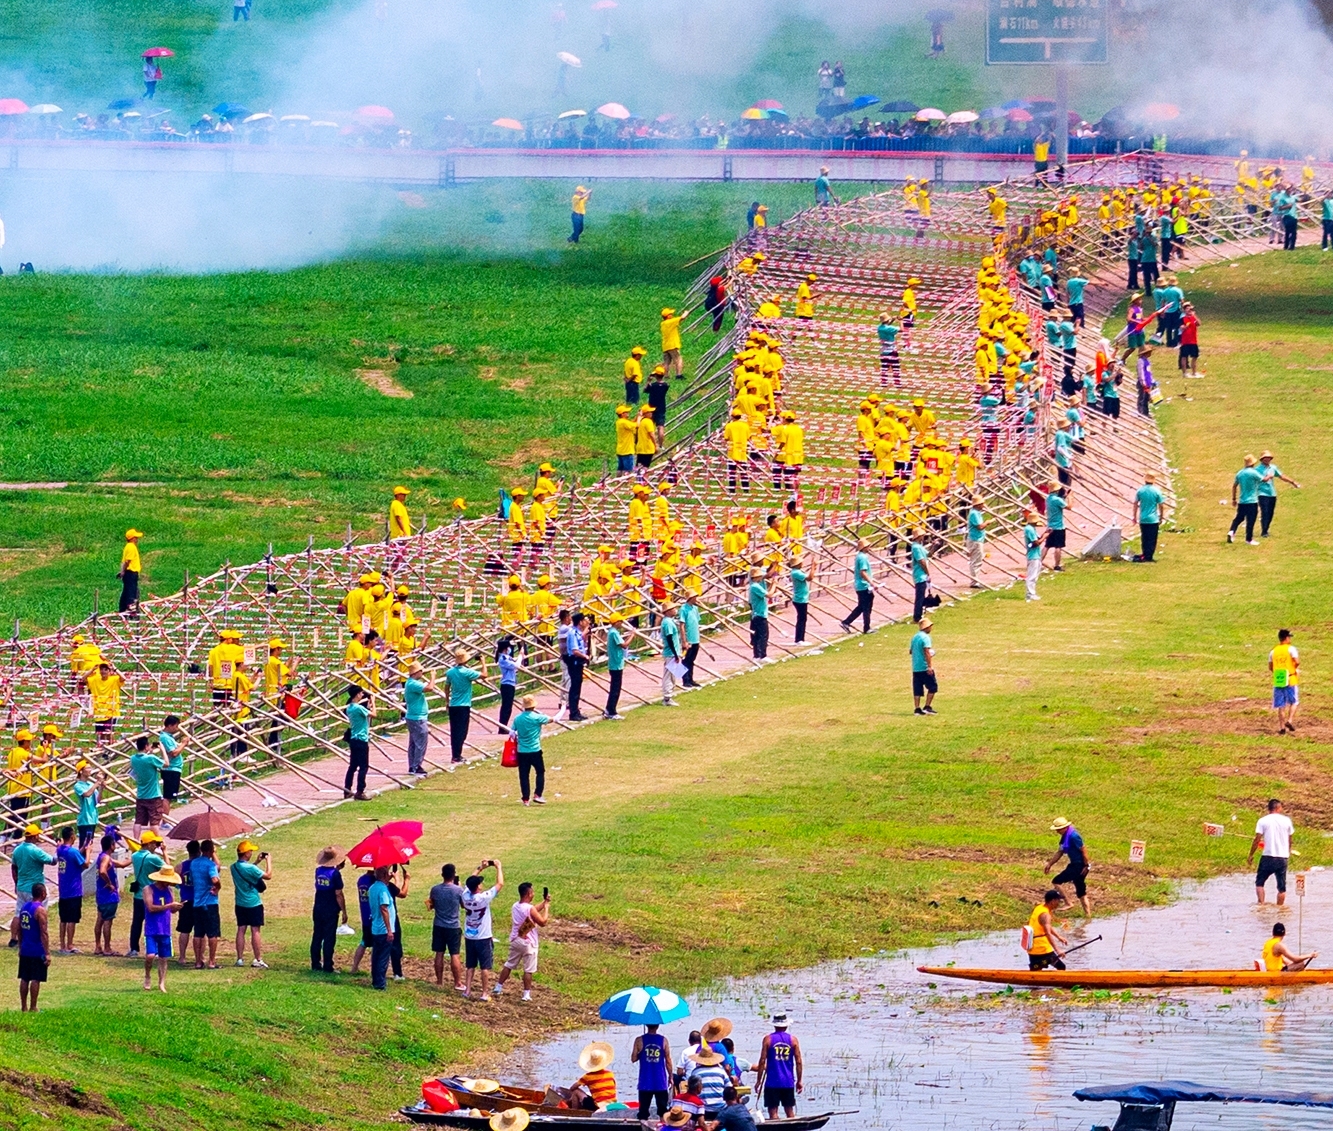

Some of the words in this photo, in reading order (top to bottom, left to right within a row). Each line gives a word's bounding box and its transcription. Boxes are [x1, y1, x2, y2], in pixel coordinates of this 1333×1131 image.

[1132, 845, 1143, 856] 172
[644, 1048, 661, 1056] 126
[774, 1046, 790, 1055] 172
